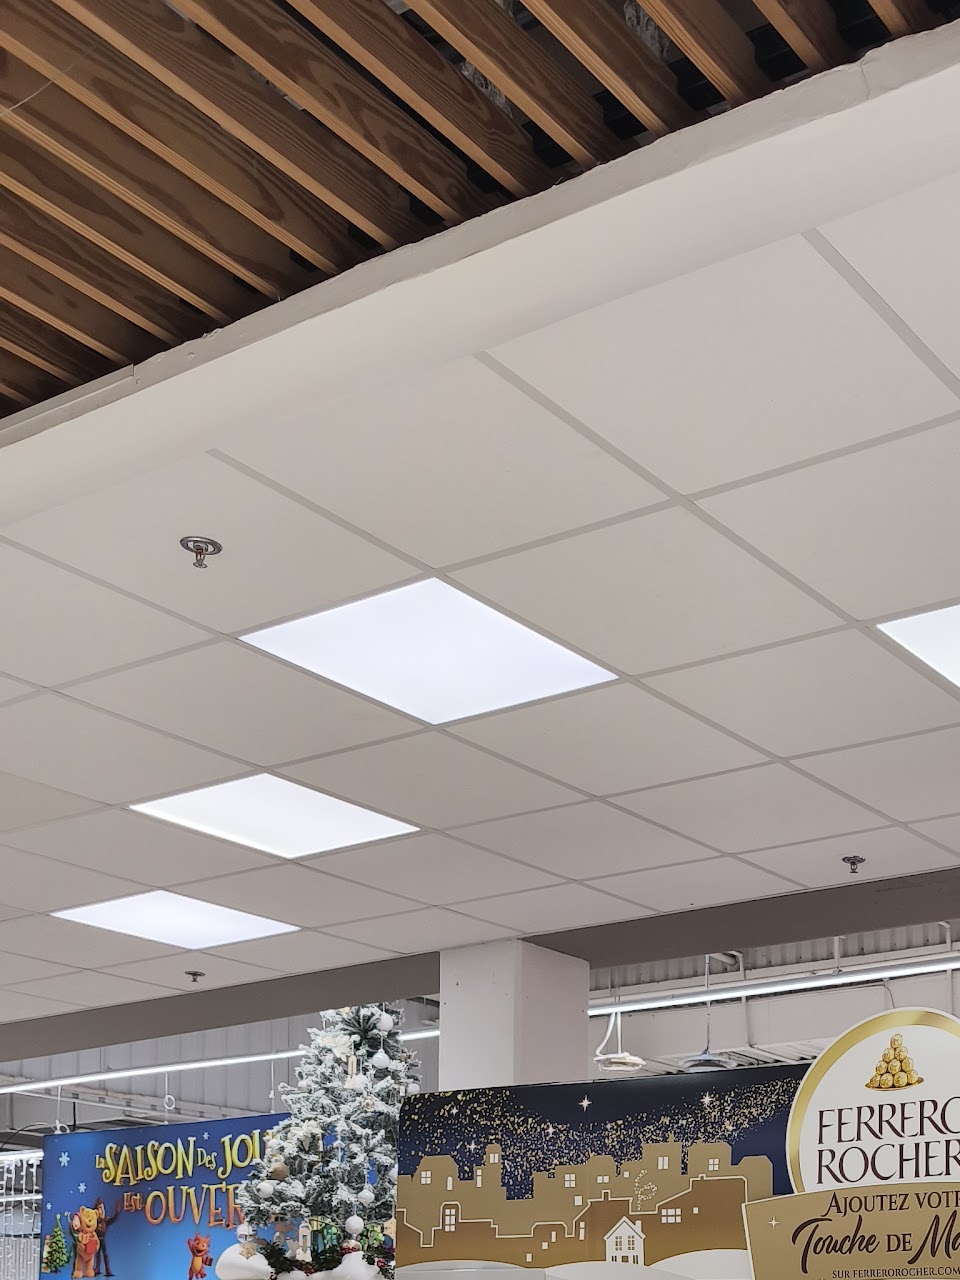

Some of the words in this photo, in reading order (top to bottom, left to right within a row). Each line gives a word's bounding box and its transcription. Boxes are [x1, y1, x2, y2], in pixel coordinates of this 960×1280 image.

[102, 1137, 196, 1185] SAISON
[820, 1191, 909, 1218] AJOUTEZ
[791, 1215, 880, 1274] Touche
[885, 1233, 912, 1253] DE
[832, 1268, 850, 1279] SUR
[853, 1266, 960, 1279] FERREROROCHER.COM
